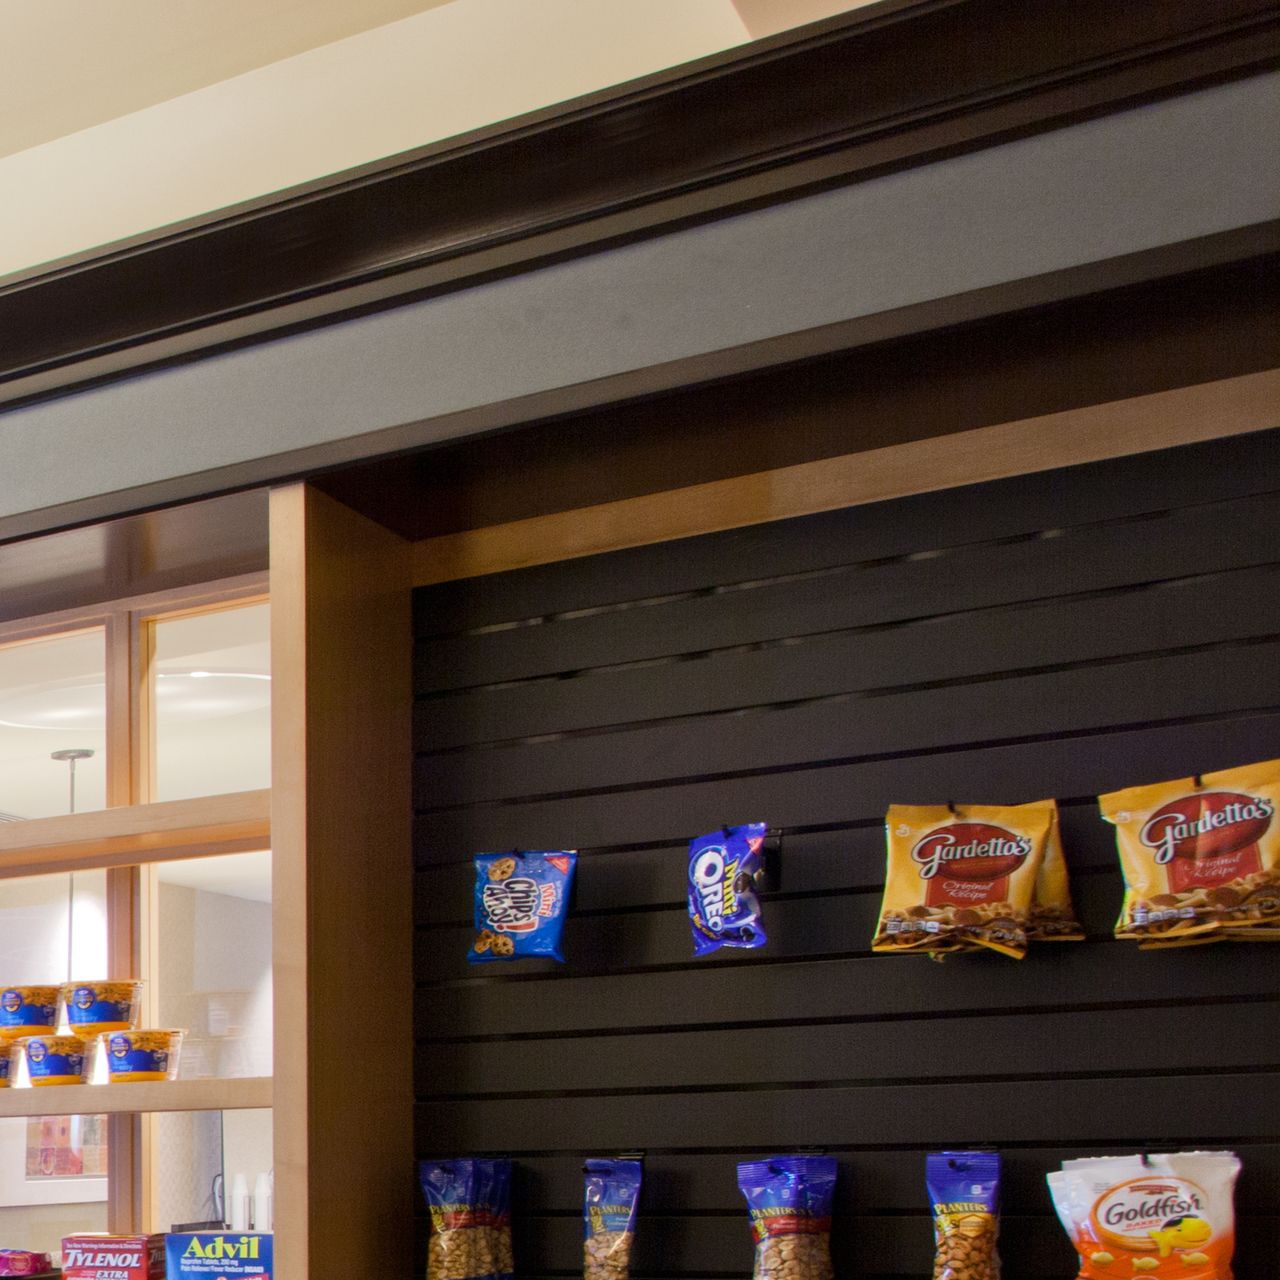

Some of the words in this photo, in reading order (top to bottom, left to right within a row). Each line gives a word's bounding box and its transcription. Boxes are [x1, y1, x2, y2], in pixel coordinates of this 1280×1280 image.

[1140, 797, 1273, 864] Gardetto's
[912, 833, 1031, 879] Gardetto's
[694, 850, 725, 932] OREO
[942, 880, 995, 892] Original
[948, 889, 988, 901] Recipe
[935, 1202, 988, 1214] PLANTERS
[1105, 1194, 1201, 1225] Goldfish
[181, 1235, 259, 1259] Advil
[64, 1249, 141, 1268] TYLENOL
[96, 1270, 129, 1279] EXTRA
